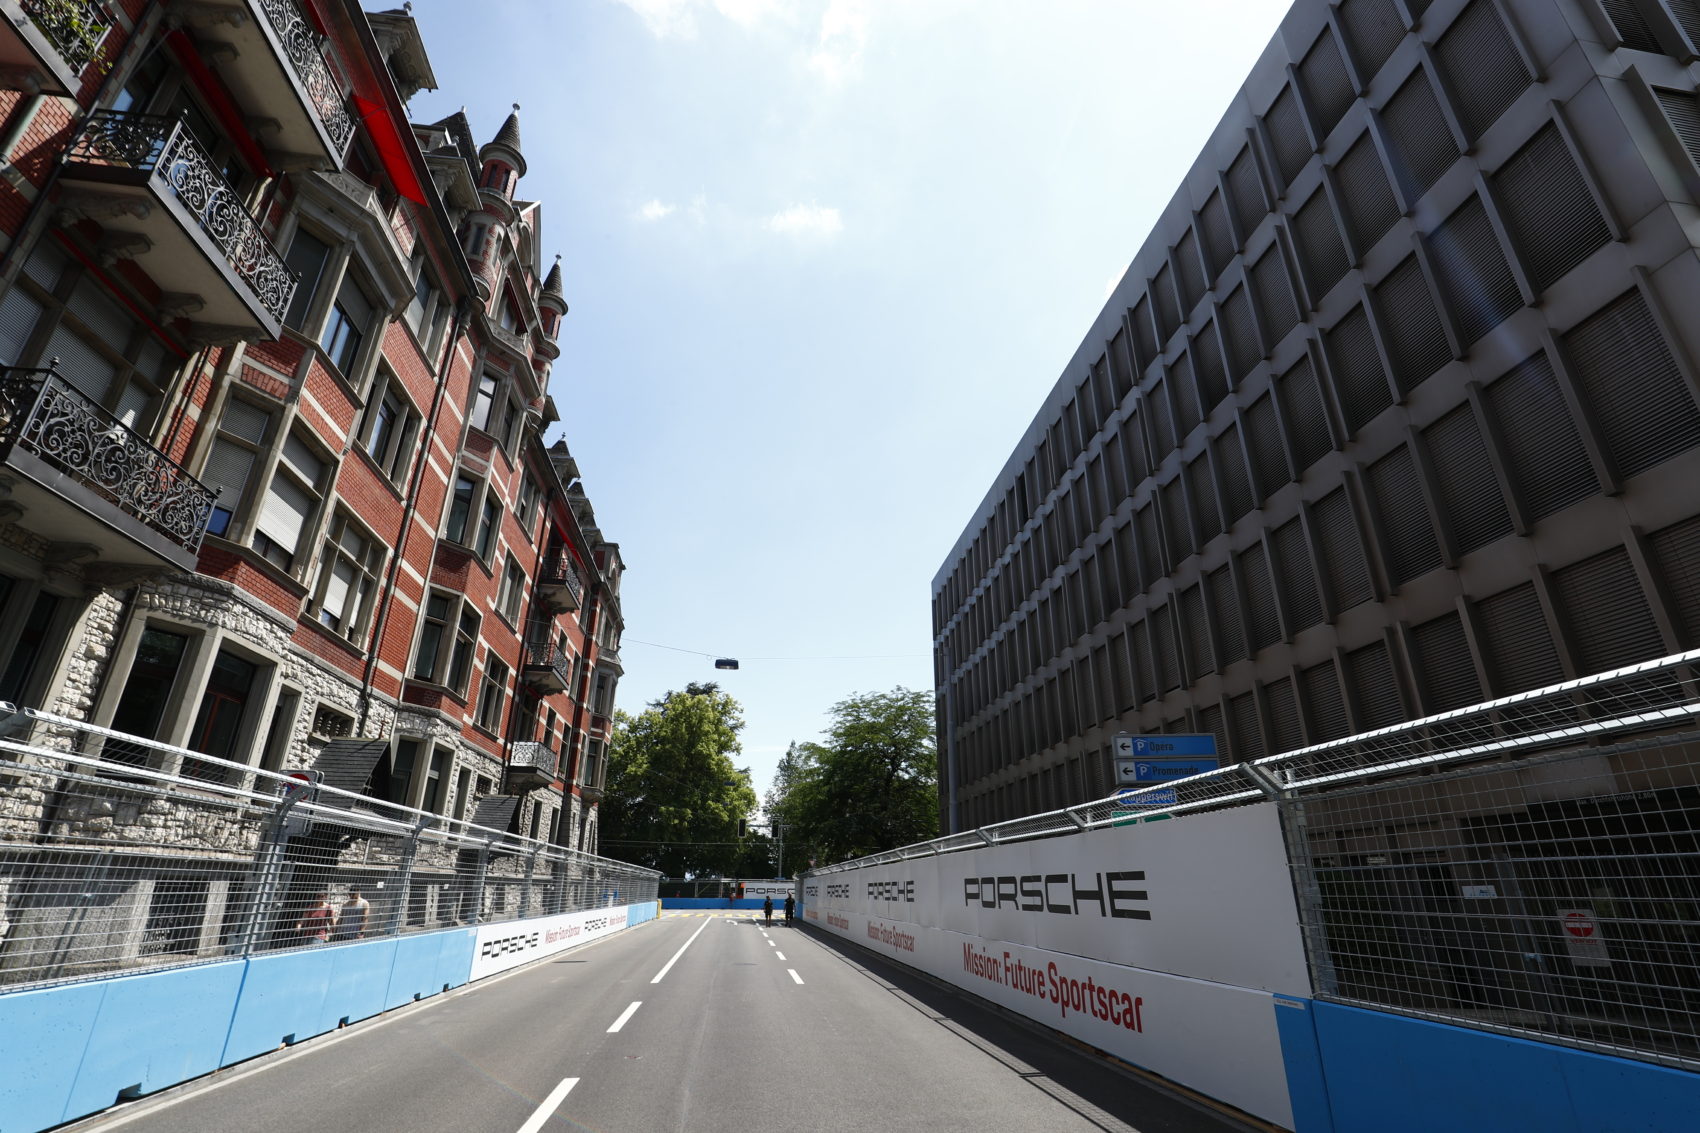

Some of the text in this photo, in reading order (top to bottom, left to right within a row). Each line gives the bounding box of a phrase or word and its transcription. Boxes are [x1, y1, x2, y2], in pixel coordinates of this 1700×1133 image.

[1152, 764, 1200, 777] Promenade
[868, 880, 915, 902] PORSCHE
[964, 871, 1151, 920] PORSCHE
[481, 932, 539, 960] PORSCHE
[963, 942, 1143, 1033] Mission: Future Sportscar
